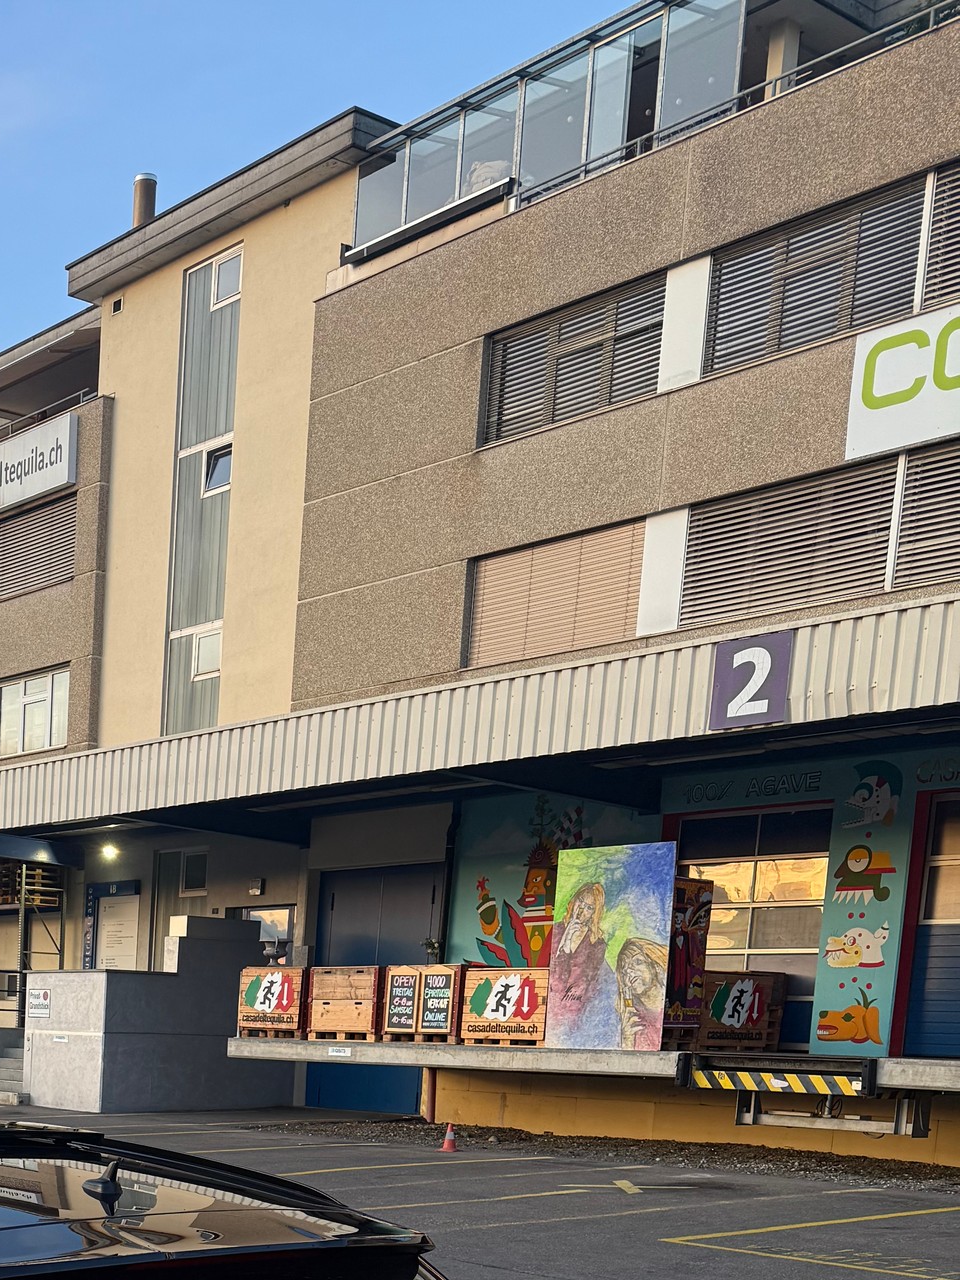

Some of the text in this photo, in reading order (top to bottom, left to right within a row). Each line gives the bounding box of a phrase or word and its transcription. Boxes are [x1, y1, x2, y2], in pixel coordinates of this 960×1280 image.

[726, 647, 772, 718] 2
[745, 770, 822, 798] AGAVE
[393, 975, 416, 987] OPEN
[427, 975, 446, 988] 4000
[392, 988, 414, 997] FREITAG
[242, 1013, 294, 1025] casadeltequila.ch
[424, 1011, 447, 1022] ONLINE
[467, 1022, 538, 1036] casadeltequila.ch
